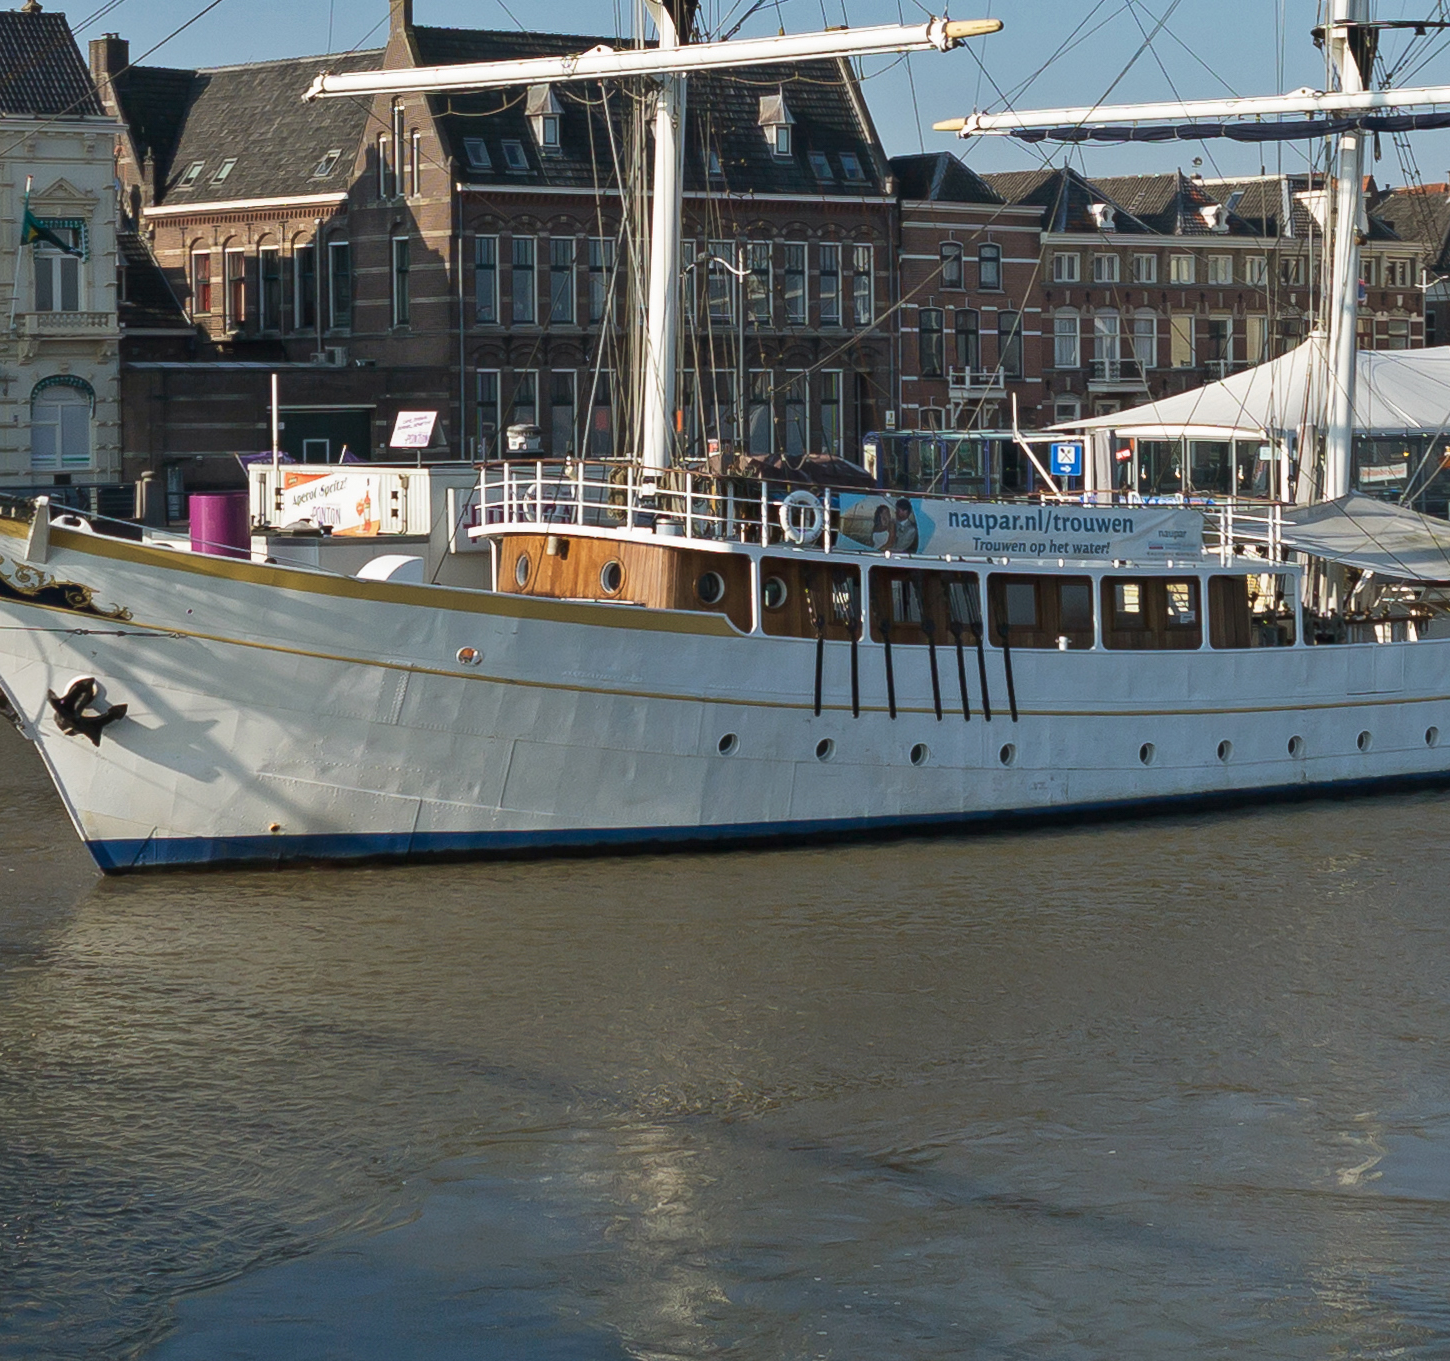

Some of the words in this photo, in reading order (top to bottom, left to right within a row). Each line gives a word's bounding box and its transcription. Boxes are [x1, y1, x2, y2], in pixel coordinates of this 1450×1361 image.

[292, 486, 317, 507] Aperol
[949, 509, 1134, 535] naupar.nl/trouwen
[1158, 530, 1187, 539] naupar
[973, 537, 1027, 553] Trouwen
[1029, 541, 1047, 557] op
[1049, 540, 1069, 554] het
[1072, 542, 1111, 555] water!
